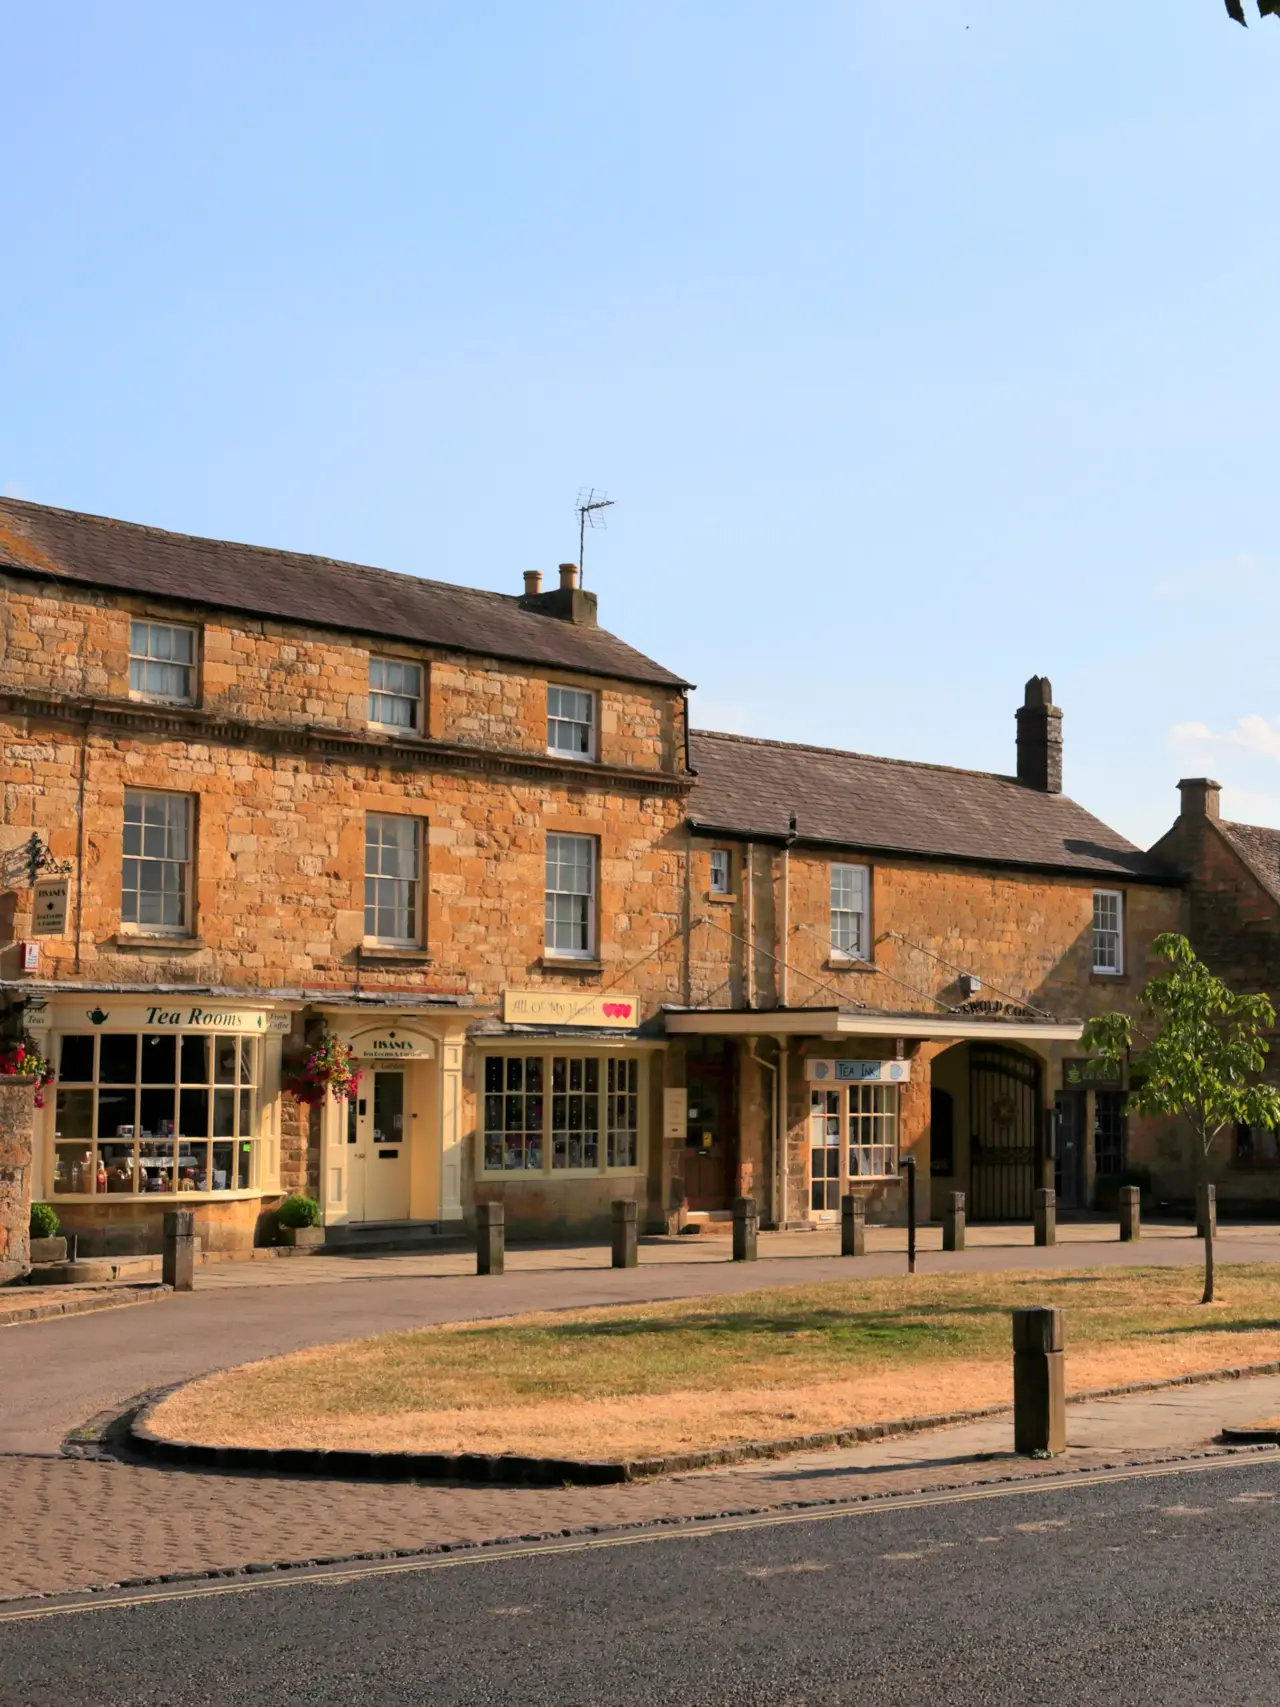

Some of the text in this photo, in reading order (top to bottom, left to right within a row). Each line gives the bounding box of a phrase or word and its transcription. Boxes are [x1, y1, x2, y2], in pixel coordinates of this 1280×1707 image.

[39, 889, 66, 897] TISANES
[146, 1006, 243, 1027] Tea Rooms
[270, 1012, 288, 1020] Fresh
[268, 1021, 289, 1030] Coffee
[373, 1041, 413, 1049] TISANES
[839, 1064, 855, 1077] TEA
